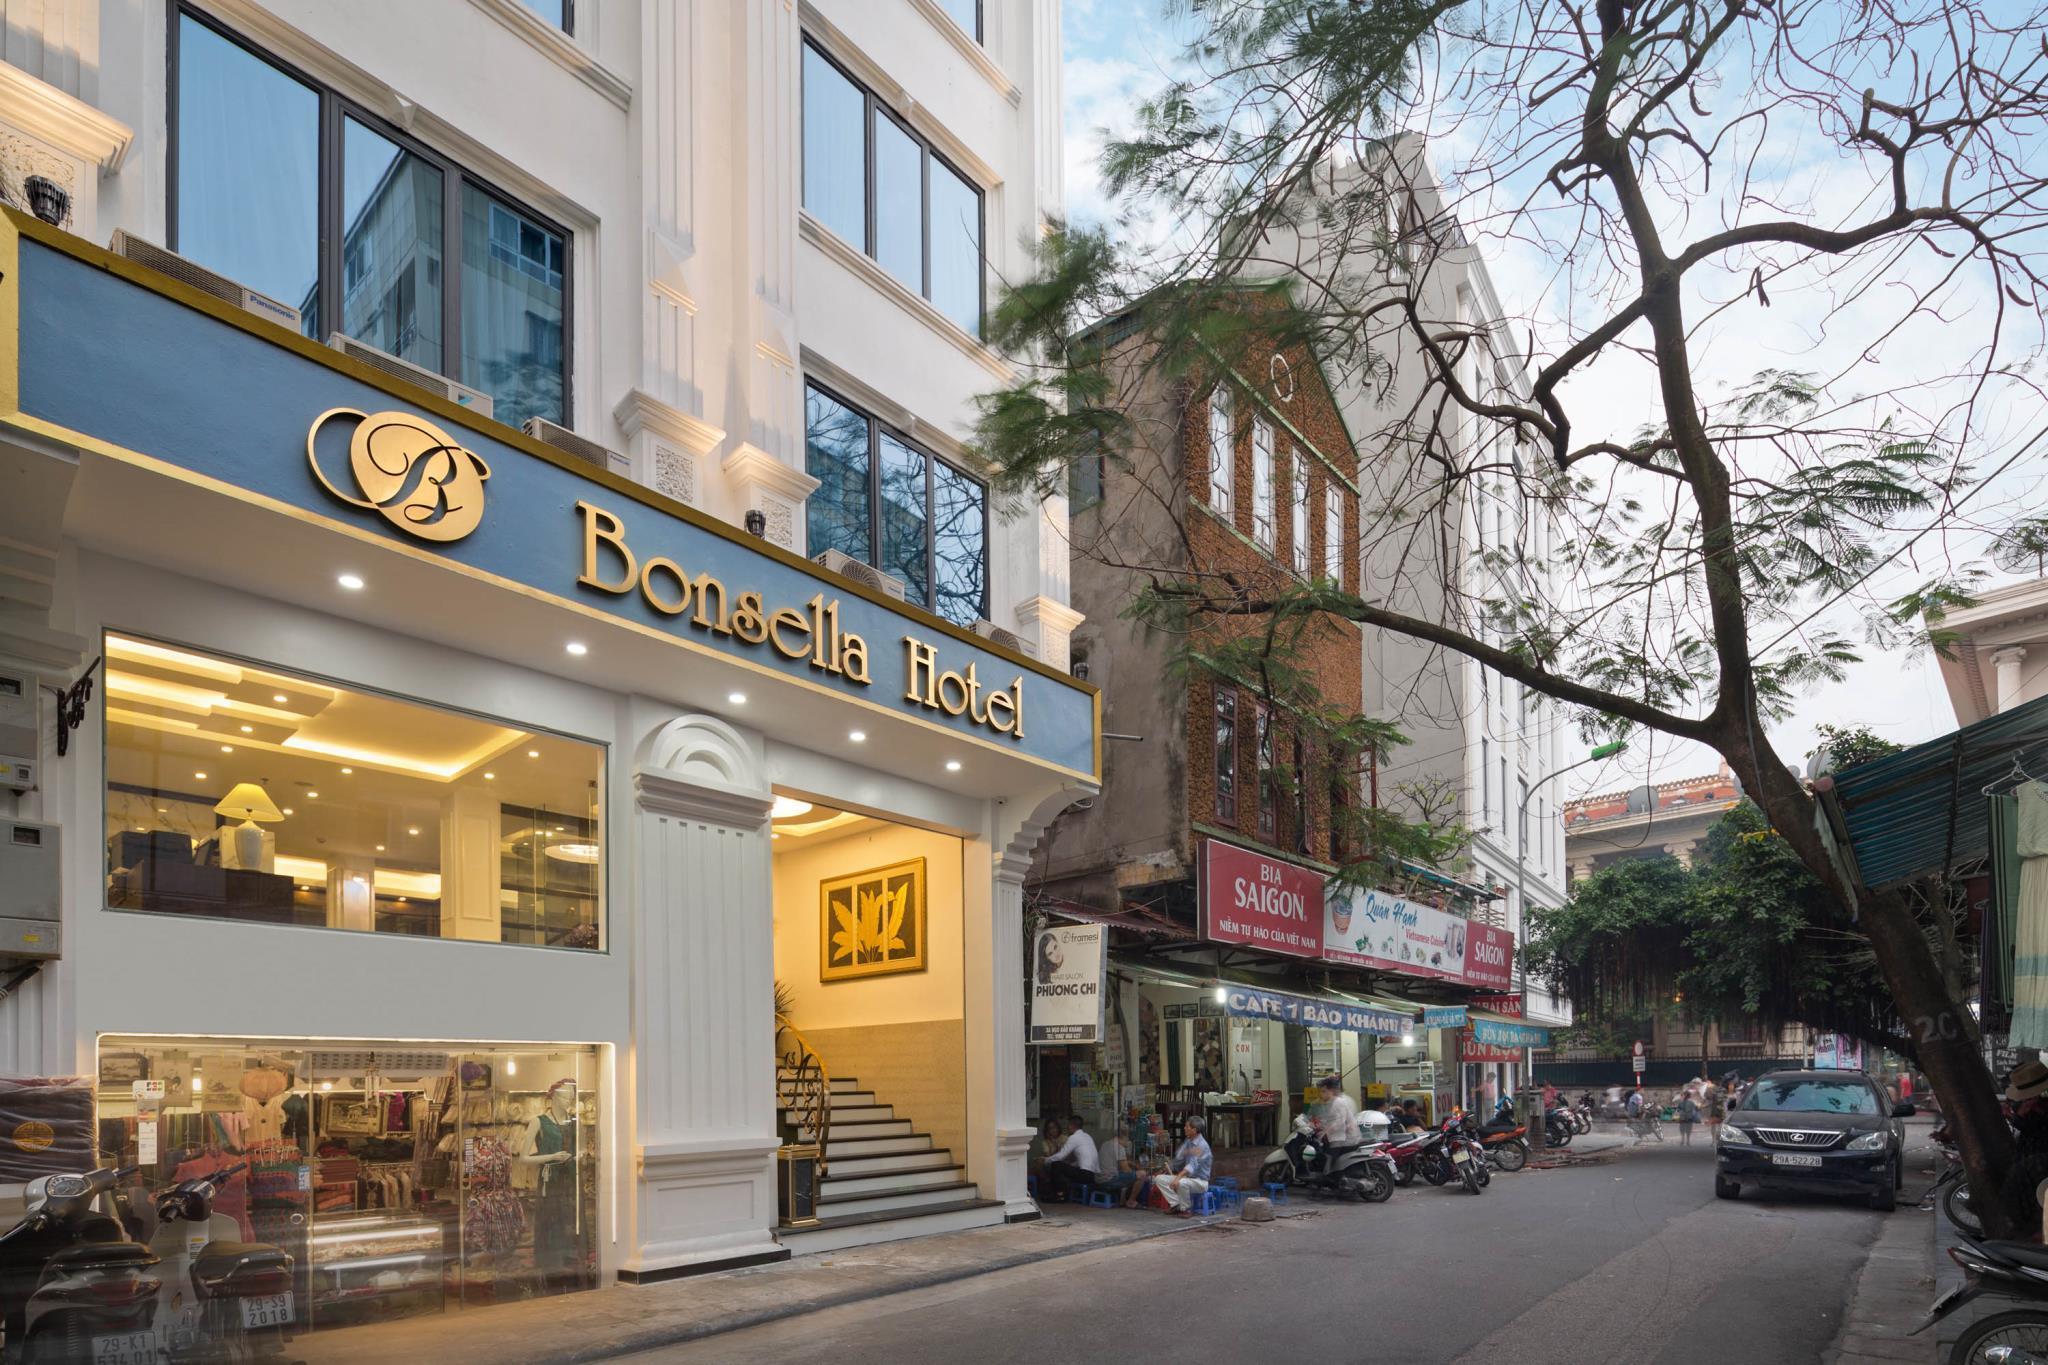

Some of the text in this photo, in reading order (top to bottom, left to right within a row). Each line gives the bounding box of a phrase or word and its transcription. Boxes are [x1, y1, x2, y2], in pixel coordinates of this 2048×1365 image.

[250, 295, 296, 321] Panasonic
[576, 500, 1026, 739] Bonsella Hotel
[1261, 864, 1282, 885] BIA
[1235, 877, 1304, 921] SAIGON
[1365, 894, 1389, 923] Quán
[1270, 928, 1285, 943] CỦA
[1301, 936, 1316, 949] NAM
[1487, 930, 1496, 944] BIA
[1475, 941, 1505, 967] SAIGON
[1080, 982, 1096, 995] CHI
[1286, 1003, 1298, 1018] 1
[1303, 1004, 1342, 1025] BẢO
[248, 1295, 286, 1312] 29-S9
[249, 1308, 288, 1326] 2018
[102, 1335, 146, 1353] 29-K1
